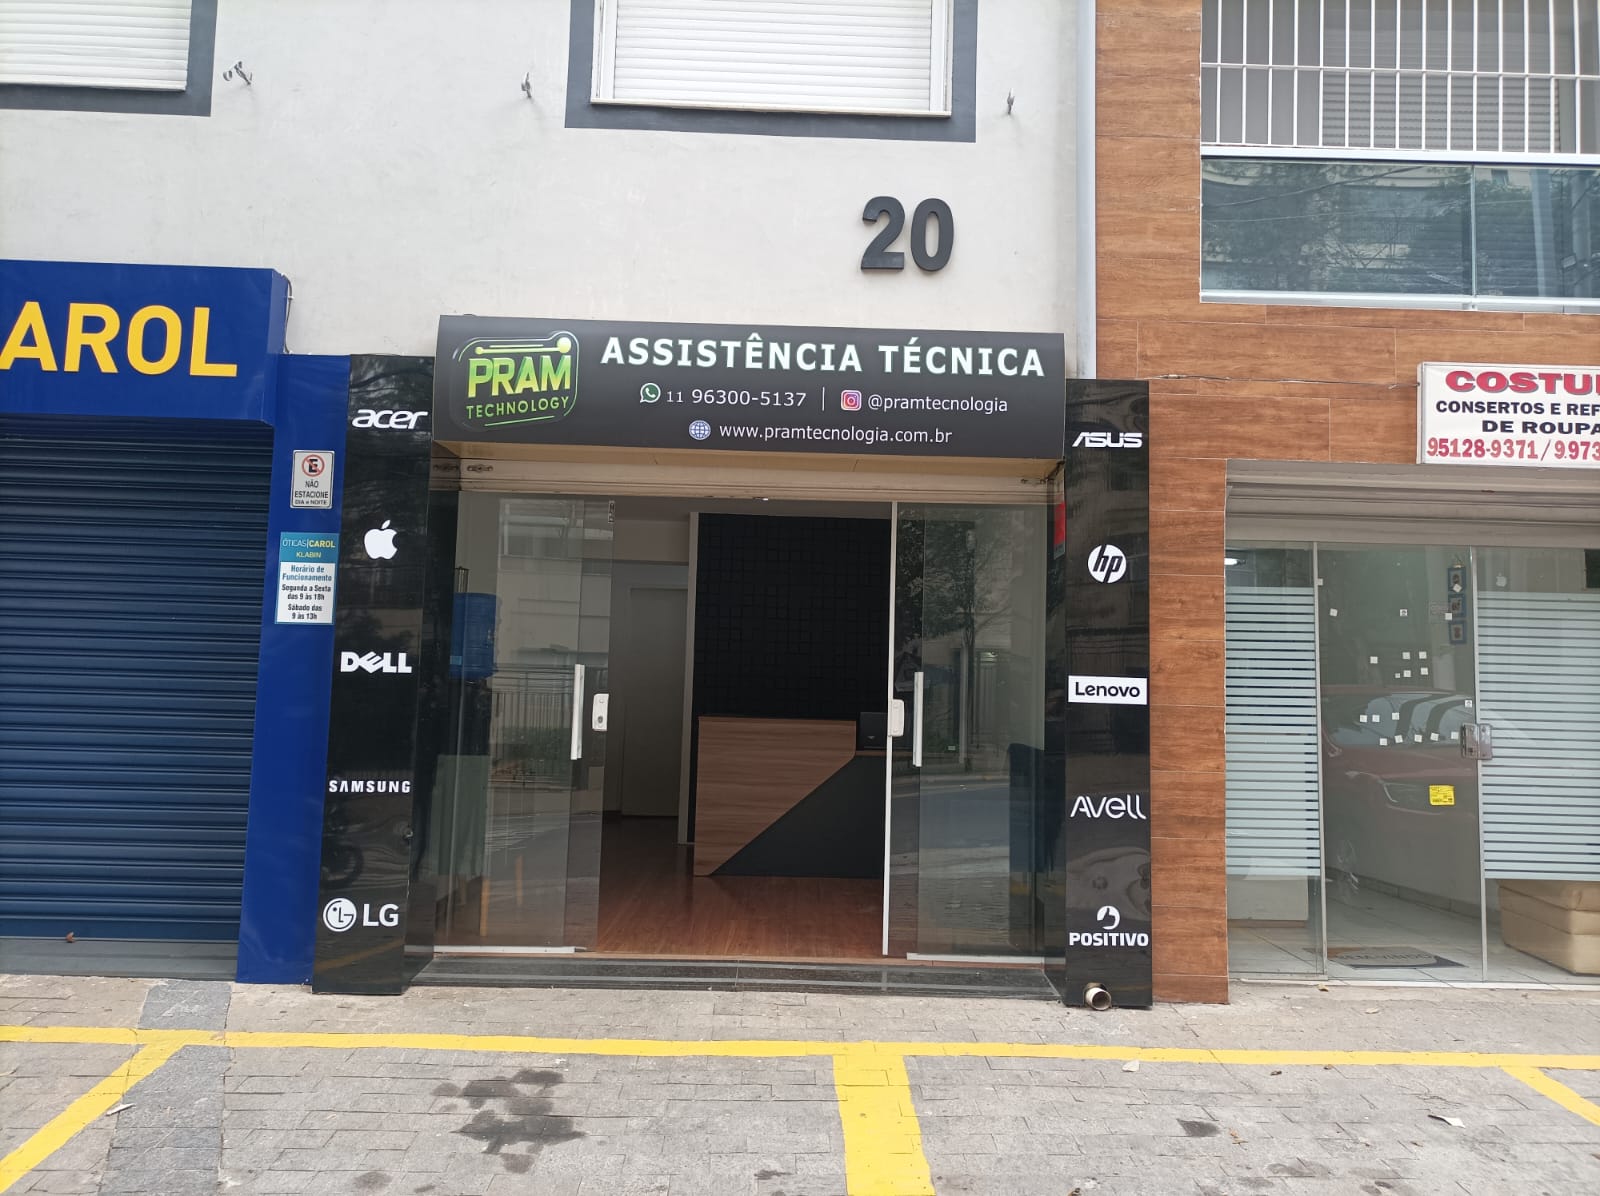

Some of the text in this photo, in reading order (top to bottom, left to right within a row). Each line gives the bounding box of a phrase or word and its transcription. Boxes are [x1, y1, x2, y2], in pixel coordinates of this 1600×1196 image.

[861, 196, 954, 271] 20
[0, 301, 238, 377] AROL
[600, 333, 1045, 376] ASSISTÊNCIA TÉCNICA
[468, 355, 572, 398] PRAM
[1445, 370, 1600, 396] COSTU
[666, 388, 807, 407] 11 96300-5137
[868, 394, 1008, 414] @pramtecnologia
[466, 396, 569, 419] TECHNOLOGY
[1436, 400, 1545, 415] CONSERTOS
[1551, 403, 1561, 415] E
[352, 409, 429, 430] acer
[1482, 420, 1514, 433] DE
[719, 425, 953, 445] www.pramtecnologia.com.br
[1072, 432, 1143, 449] ASUS
[305, 479, 319, 488] NÃO
[294, 490, 329, 498] ESTACIONE
[291, 565, 325, 573] Horário de
[1091, 544, 1124, 583] hp
[282, 573, 332, 582] Funcionamento
[314, 585, 331, 593] Sexta
[288, 603, 310, 611] Sábado
[340, 651, 412, 673] DELL
[1075, 681, 1140, 698] Lenovo
[329, 780, 411, 793] SAMSUNG
[1070, 795, 1147, 820] Avell
[363, 903, 399, 927] LG
[1069, 932, 1149, 947] POSITIVO
